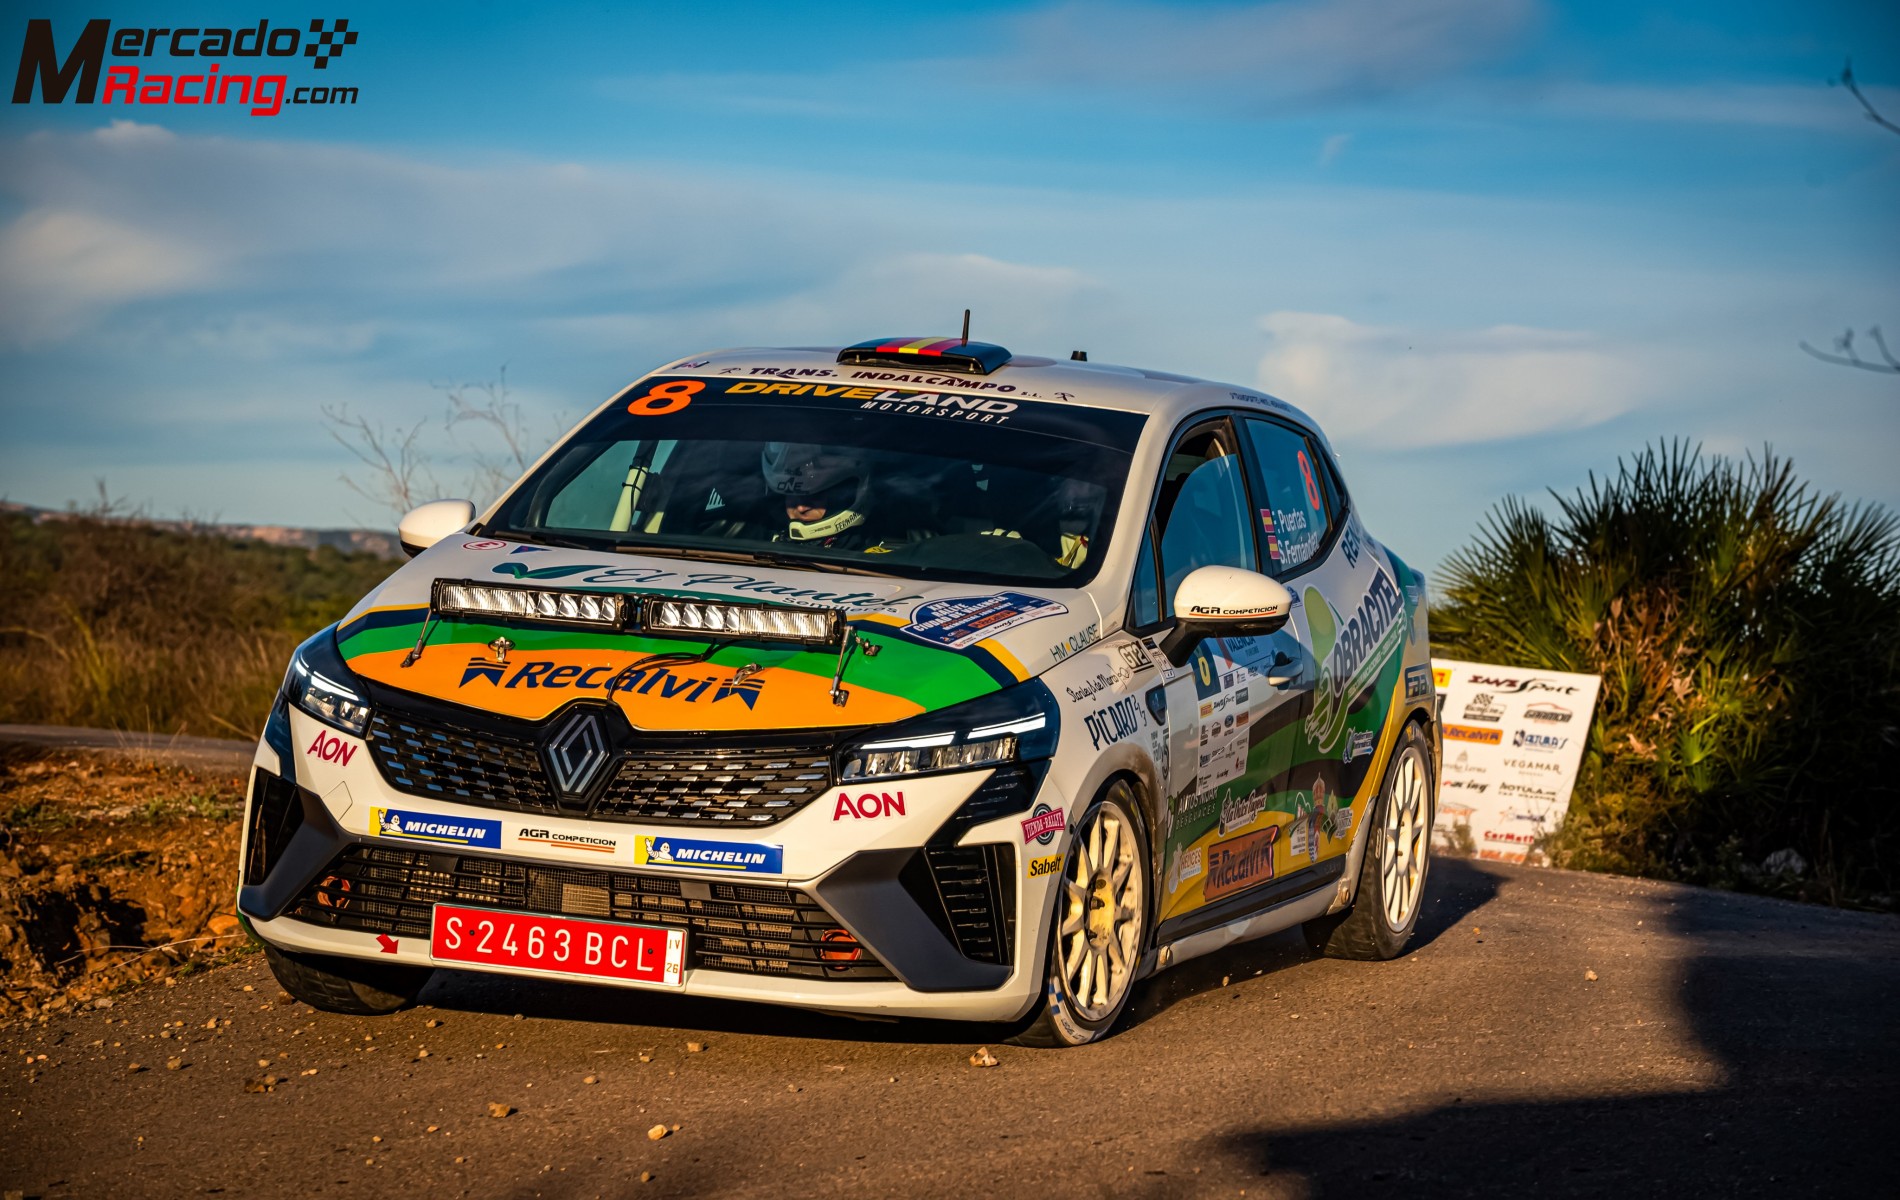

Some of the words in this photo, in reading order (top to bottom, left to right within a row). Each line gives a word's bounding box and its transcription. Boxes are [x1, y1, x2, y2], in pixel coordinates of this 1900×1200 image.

[750, 368, 838, 378] TRANS.
[851, 371, 1017, 393] INDALCAMPO
[627, 380, 707, 416] 8
[725, 381, 1019, 414] DRIVELAND
[860, 401, 1010, 425] MOTORSPORT
[1297, 450, 1320, 511] 8
[582, 568, 678, 583] El
[1191, 605, 1221, 614] AGR
[1223, 605, 1278, 615] COMPETICION
[913, 613, 953, 632] CIUDAD
[505, 661, 717, 703] Recalvi
[307, 729, 357, 767] AON
[1503, 758, 1562, 774] VEGAMAR
[833, 791, 906, 821] AON
[404, 820, 486, 839] MICHELIN
[519, 828, 550, 839] AGR
[552, 834, 617, 847] COMPETICION
[676, 847, 766, 865] MICHELIN
[1030, 855, 1062, 877] Sabelt
[445, 917, 463, 949] S
[476, 920, 571, 962] 2463
[585, 932, 654, 972] BCL
[666, 962, 679, 974] 26
